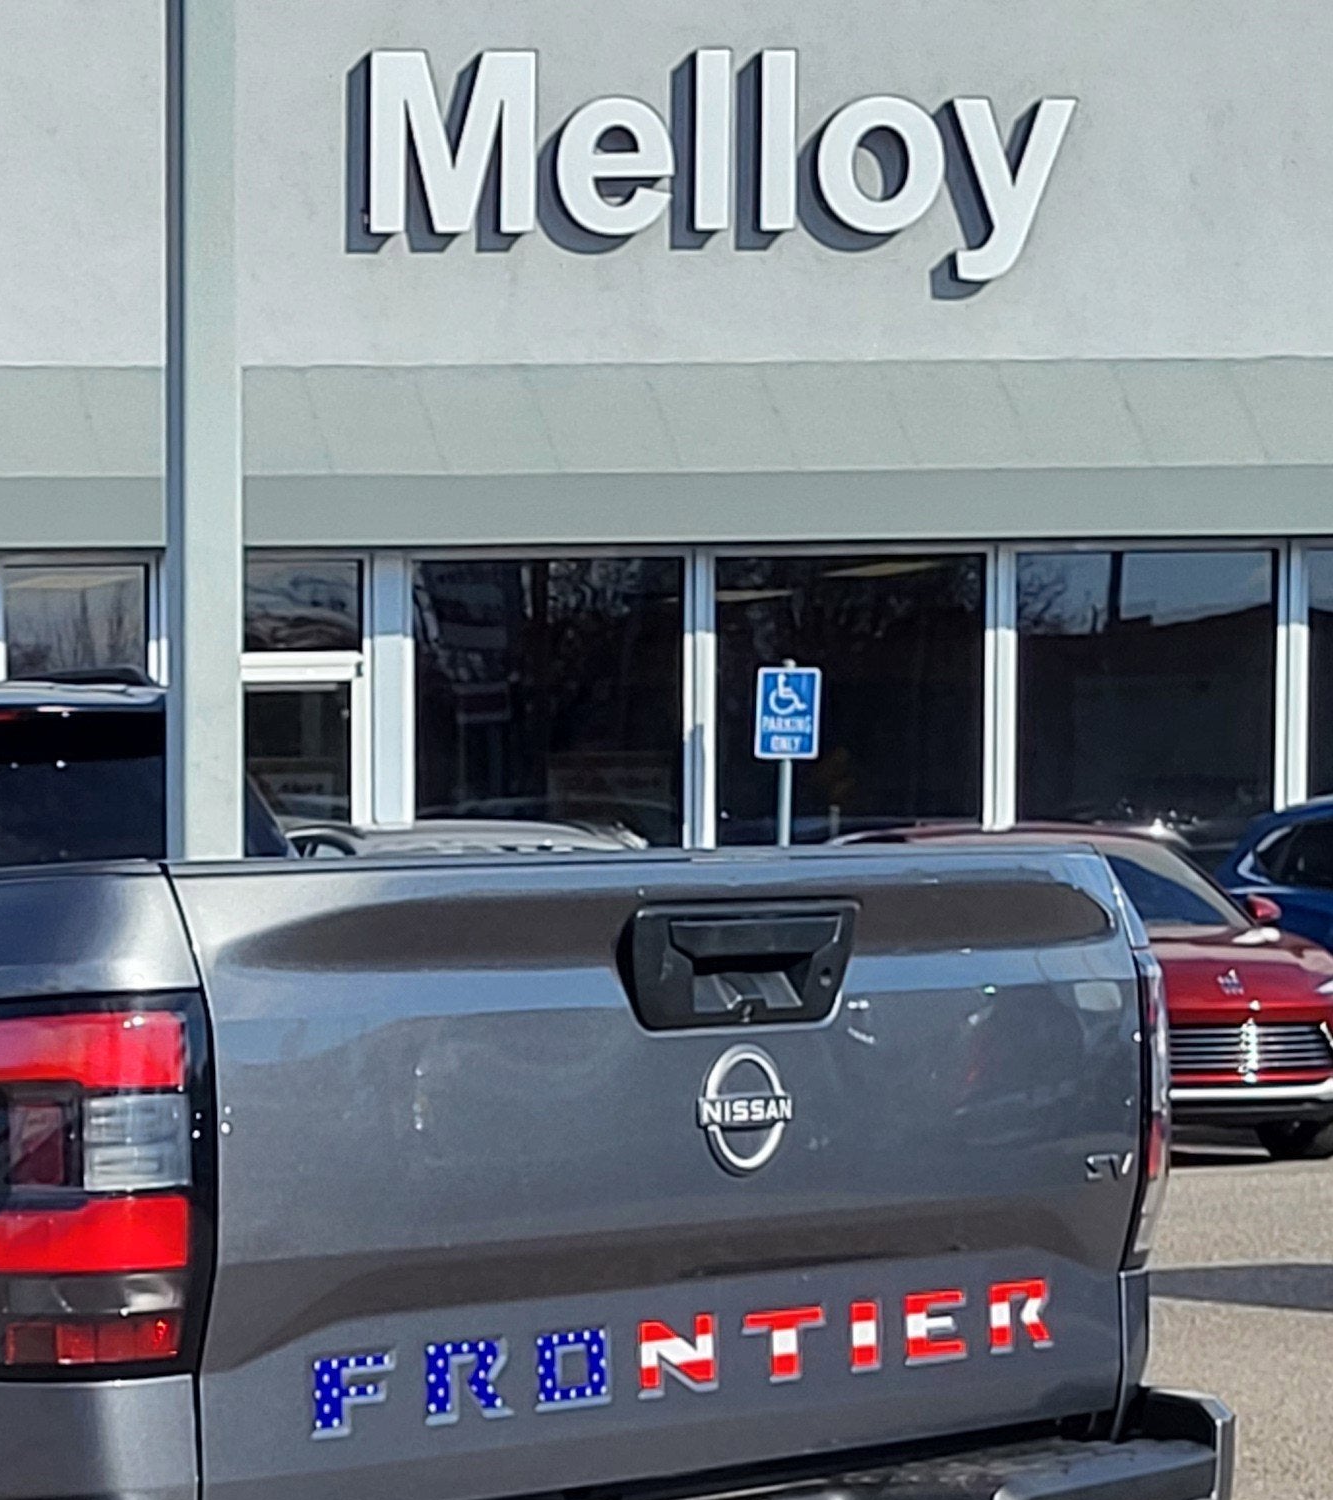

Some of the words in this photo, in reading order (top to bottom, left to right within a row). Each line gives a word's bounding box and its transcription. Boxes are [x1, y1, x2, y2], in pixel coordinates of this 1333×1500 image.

[353, 47, 1079, 292] Melloy
[762, 715, 812, 734] PARKING
[770, 735, 802, 751] ONLY
[701, 1097, 793, 1124] NISSAN
[1084, 1151, 1134, 1181] SV
[311, 1276, 1056, 1440] FRONTIER
